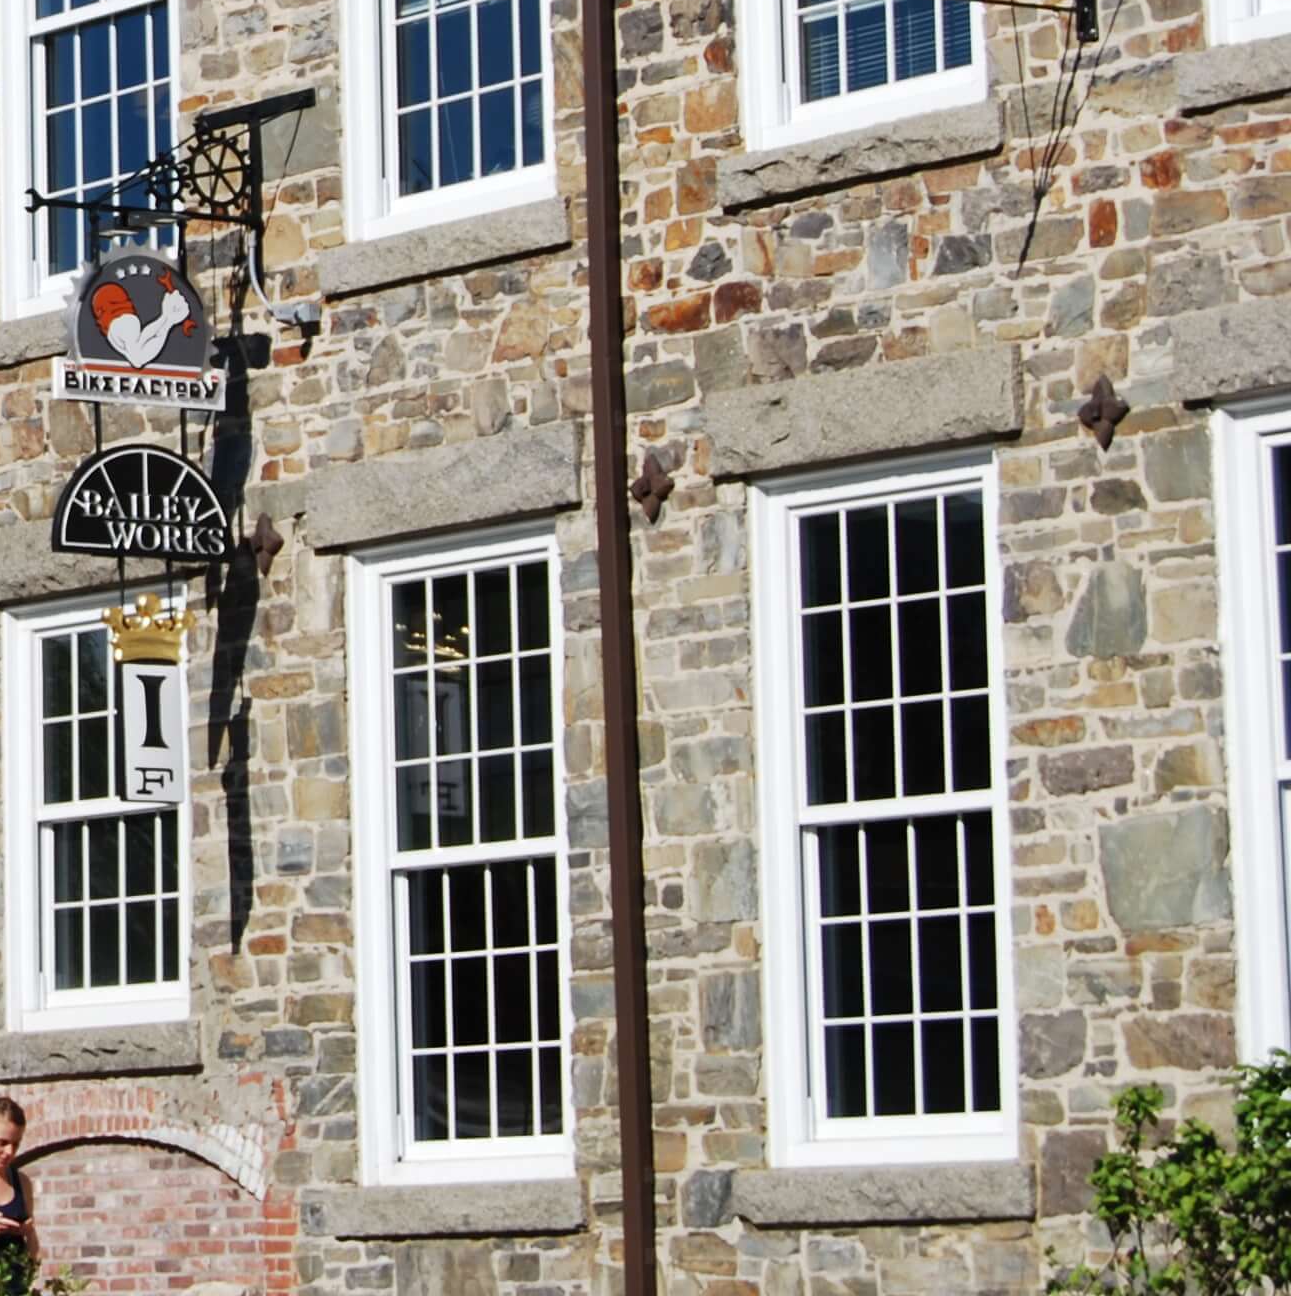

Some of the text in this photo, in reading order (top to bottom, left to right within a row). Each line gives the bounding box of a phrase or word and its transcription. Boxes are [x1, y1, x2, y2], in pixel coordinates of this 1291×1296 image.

[81, 489, 202, 524] BAILEY
[105, 521, 226, 555] WORKS
[136, 767, 174, 795] F
